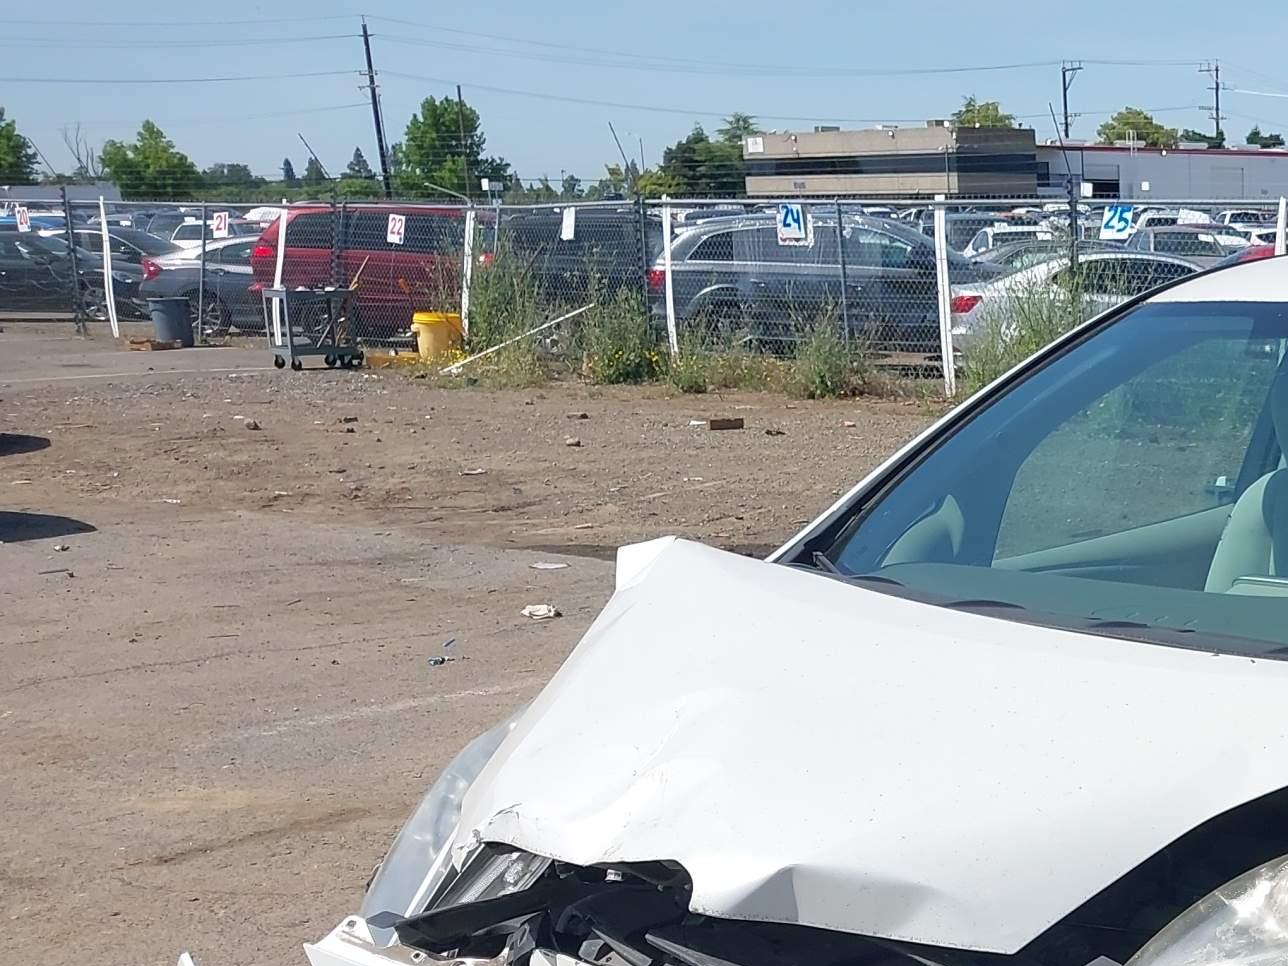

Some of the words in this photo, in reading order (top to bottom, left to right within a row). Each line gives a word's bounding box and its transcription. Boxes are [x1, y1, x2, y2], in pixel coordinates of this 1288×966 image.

[19, 209, 29, 226] 20
[215, 214, 227, 232] 21
[390, 217, 403, 236] 22
[781, 204, 802, 232] 24
[1103, 204, 1133, 233] 25
